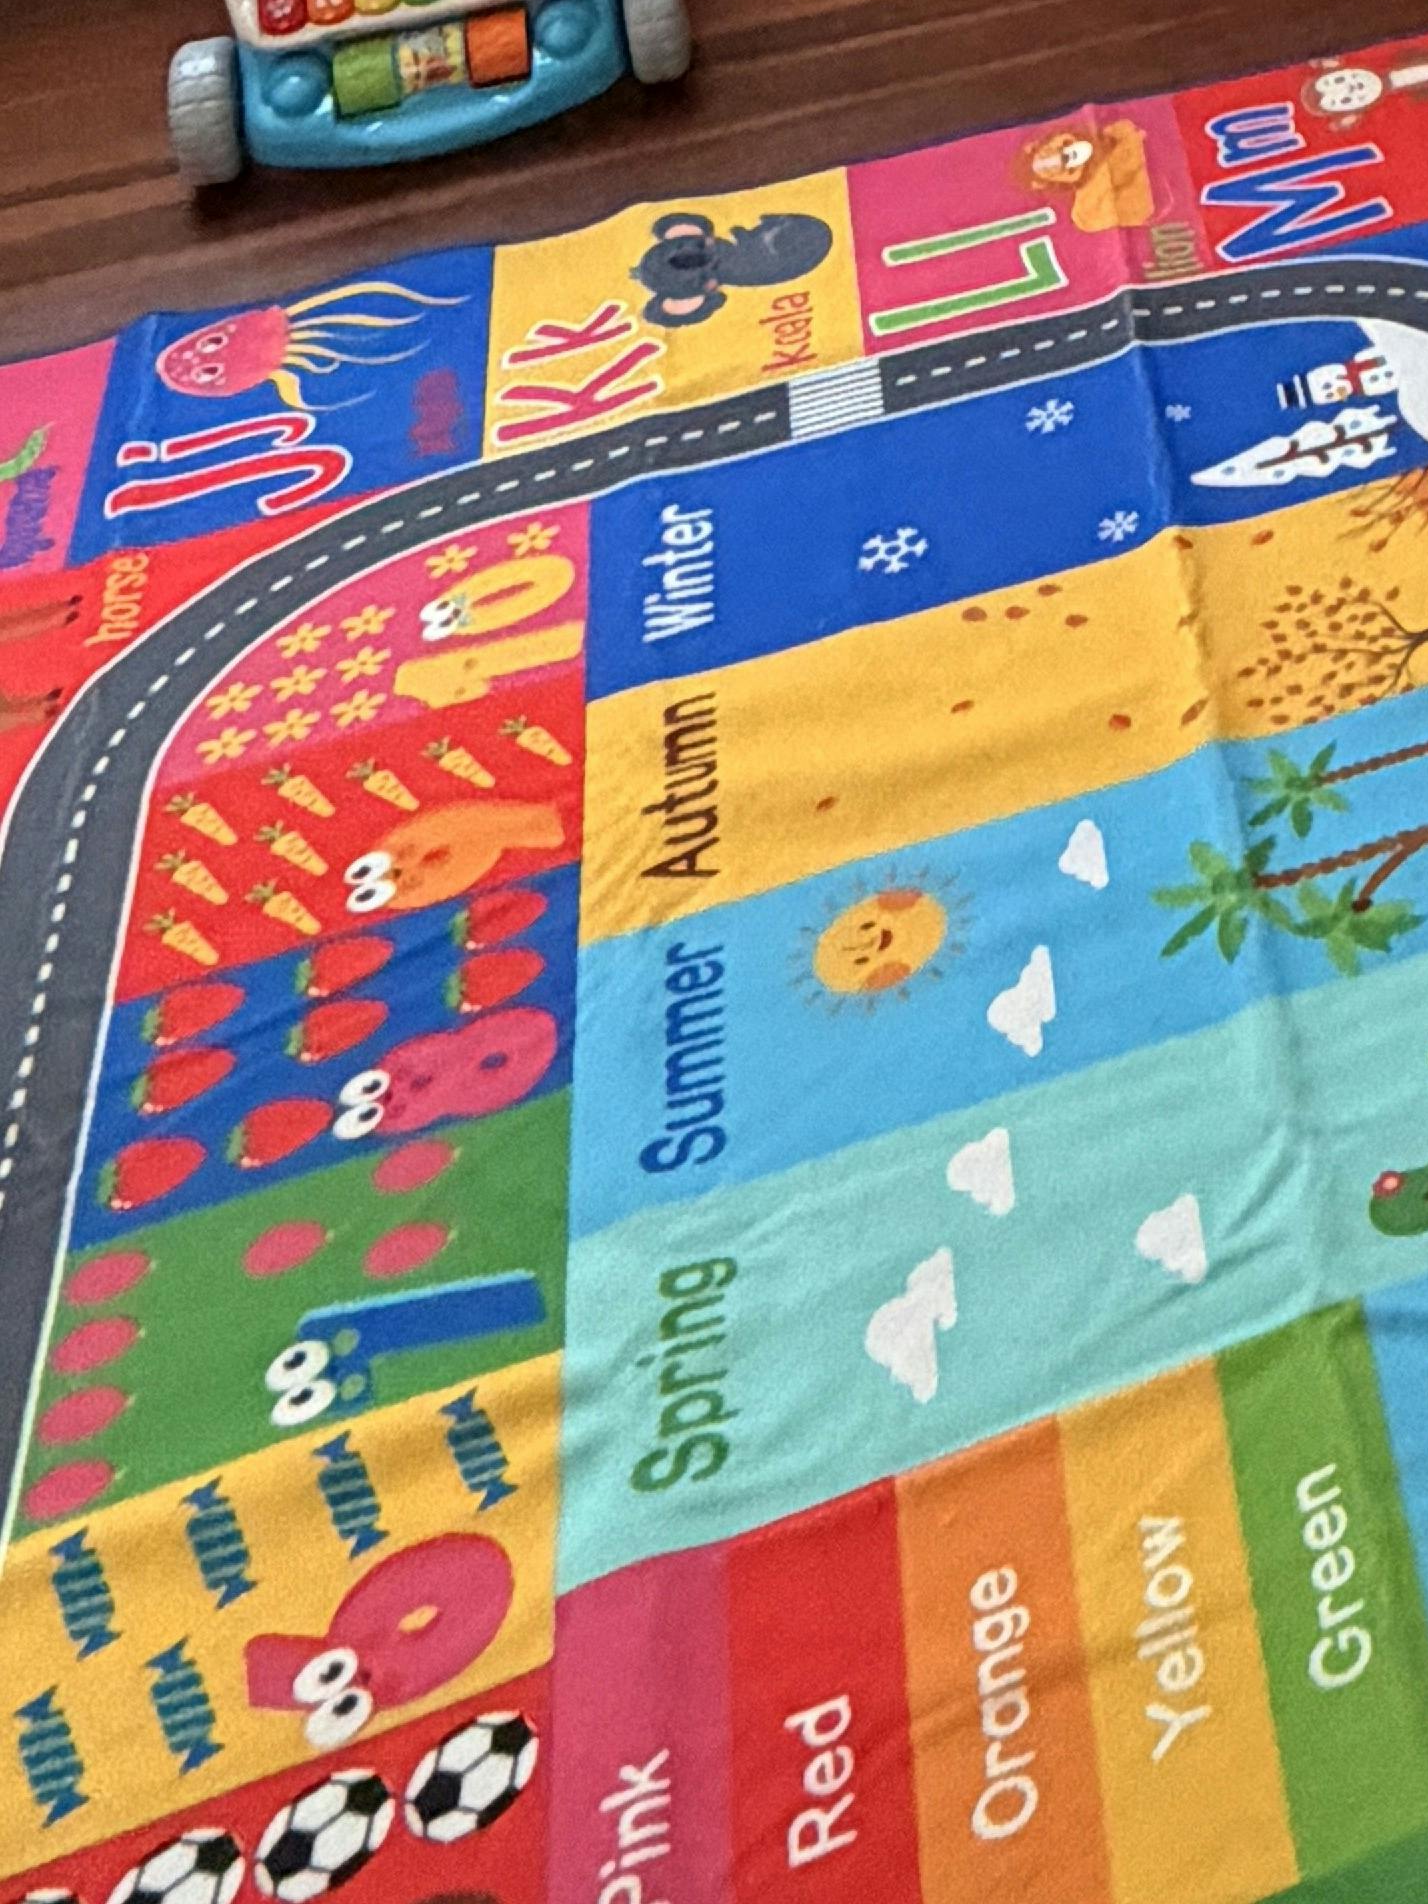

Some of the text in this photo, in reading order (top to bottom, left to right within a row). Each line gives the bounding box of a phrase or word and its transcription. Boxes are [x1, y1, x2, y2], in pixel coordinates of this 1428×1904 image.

[1144, 221, 1196, 282] lion
[83, 551, 148, 647] horse
[394, 554, 584, 710] 10
[643, 502, 714, 645] Winter
[641, 691, 719, 880] Autumn
[640, 941, 724, 1175] Summer
[630, 1256, 737, 1495] Spring
[1136, 1514, 1212, 1763] Yellow
[1295, 1463, 1372, 1691] Green
[784, 1693, 858, 1867] Red
[969, 1565, 1039, 1841] Orange
